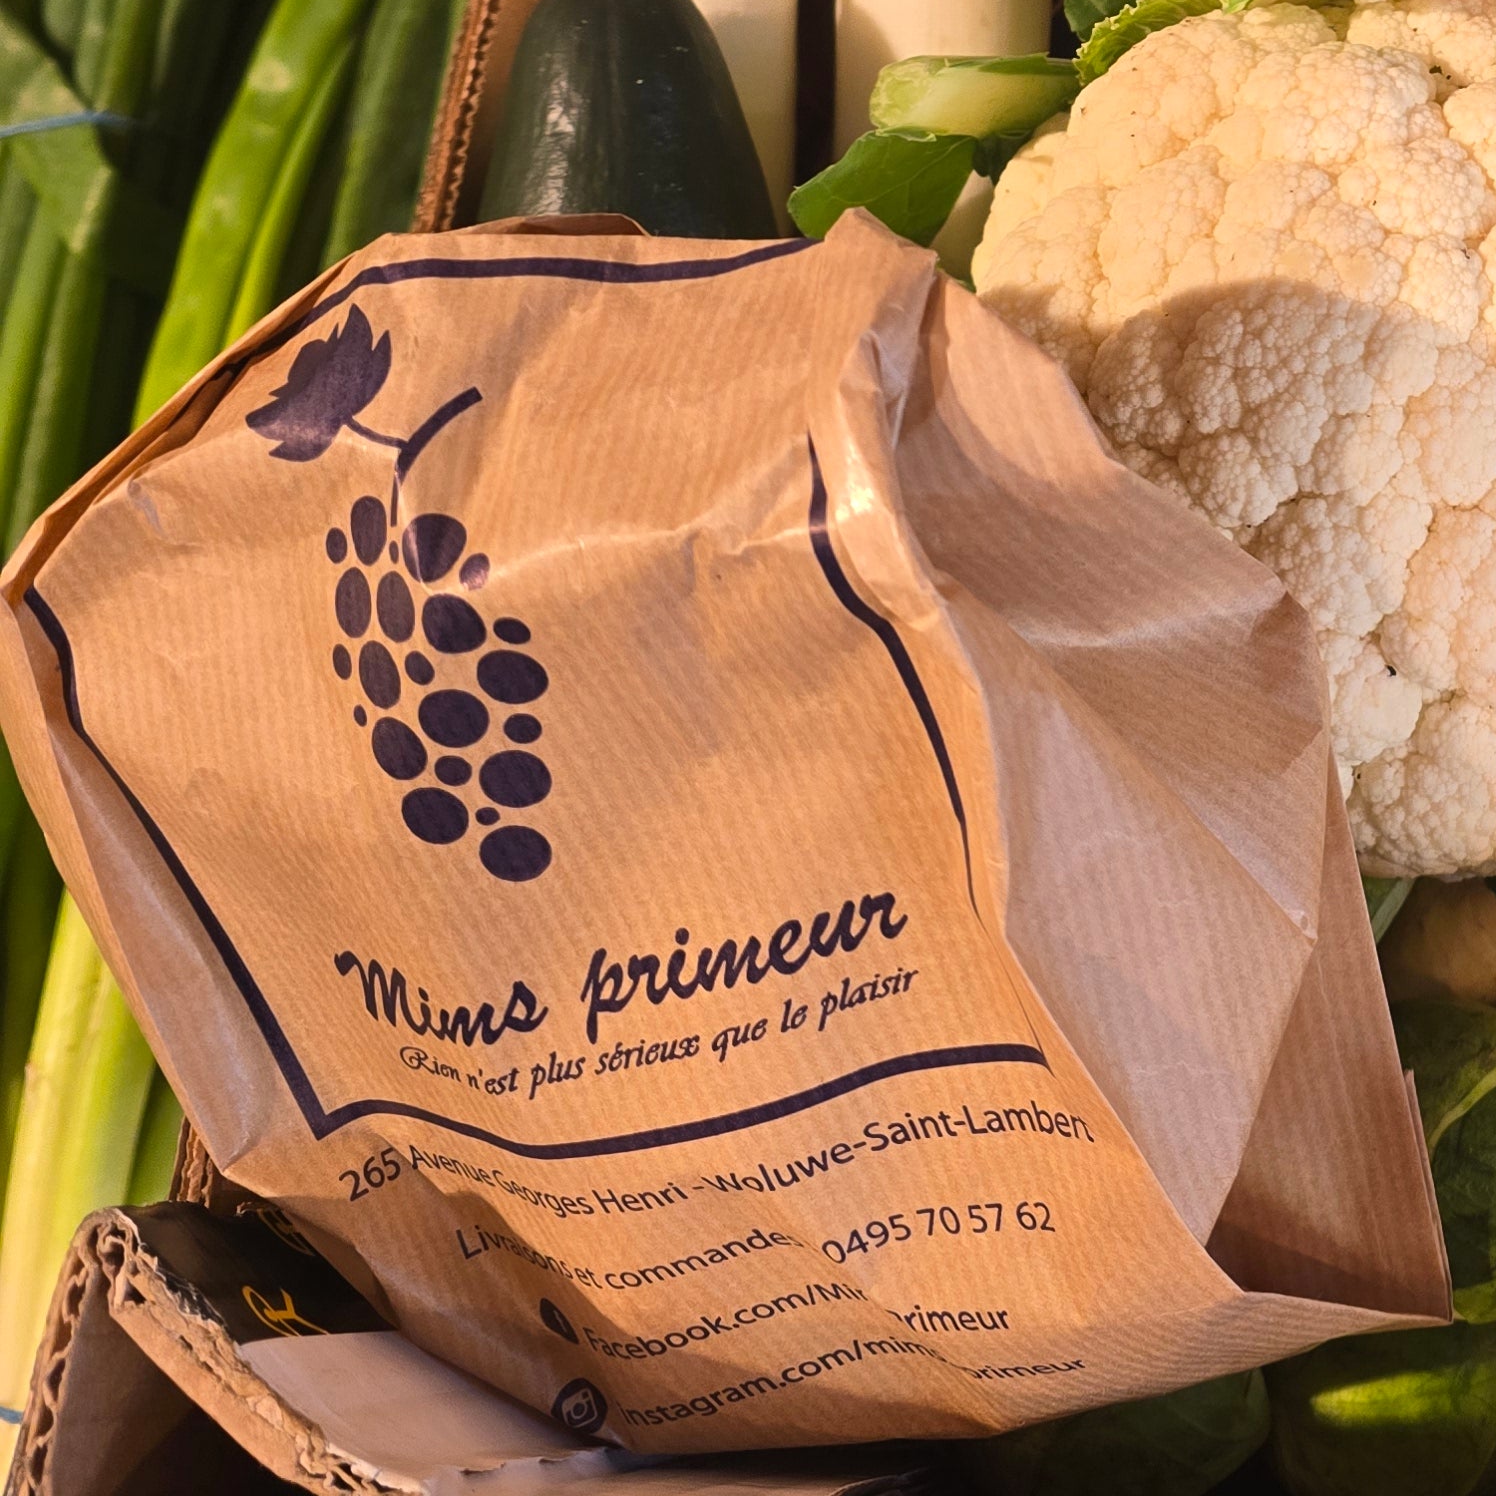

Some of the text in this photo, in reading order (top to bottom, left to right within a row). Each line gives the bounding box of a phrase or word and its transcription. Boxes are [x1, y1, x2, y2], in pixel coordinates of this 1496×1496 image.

[333, 891, 909, 1047] Mims primeur
[399, 966, 920, 1100] Rien n'est plus sérieux que le plaisir
[338, 1146, 401, 1202] 265
[407, 1144, 495, 1188] Avenue
[491, 1169, 596, 1218] Georges
[591, 1181, 689, 1215] Henri
[699, 1099, 1096, 1194] Woluwe-Saint-Lambert
[455, 1224, 575, 1282] Livraisons
[573, 1267, 605, 1290] et
[820, 1213, 913, 1265] 0495
[916, 1205, 962, 1237] 70
[967, 1202, 1003, 1234] 57
[1015, 1201, 1057, 1233] 62
